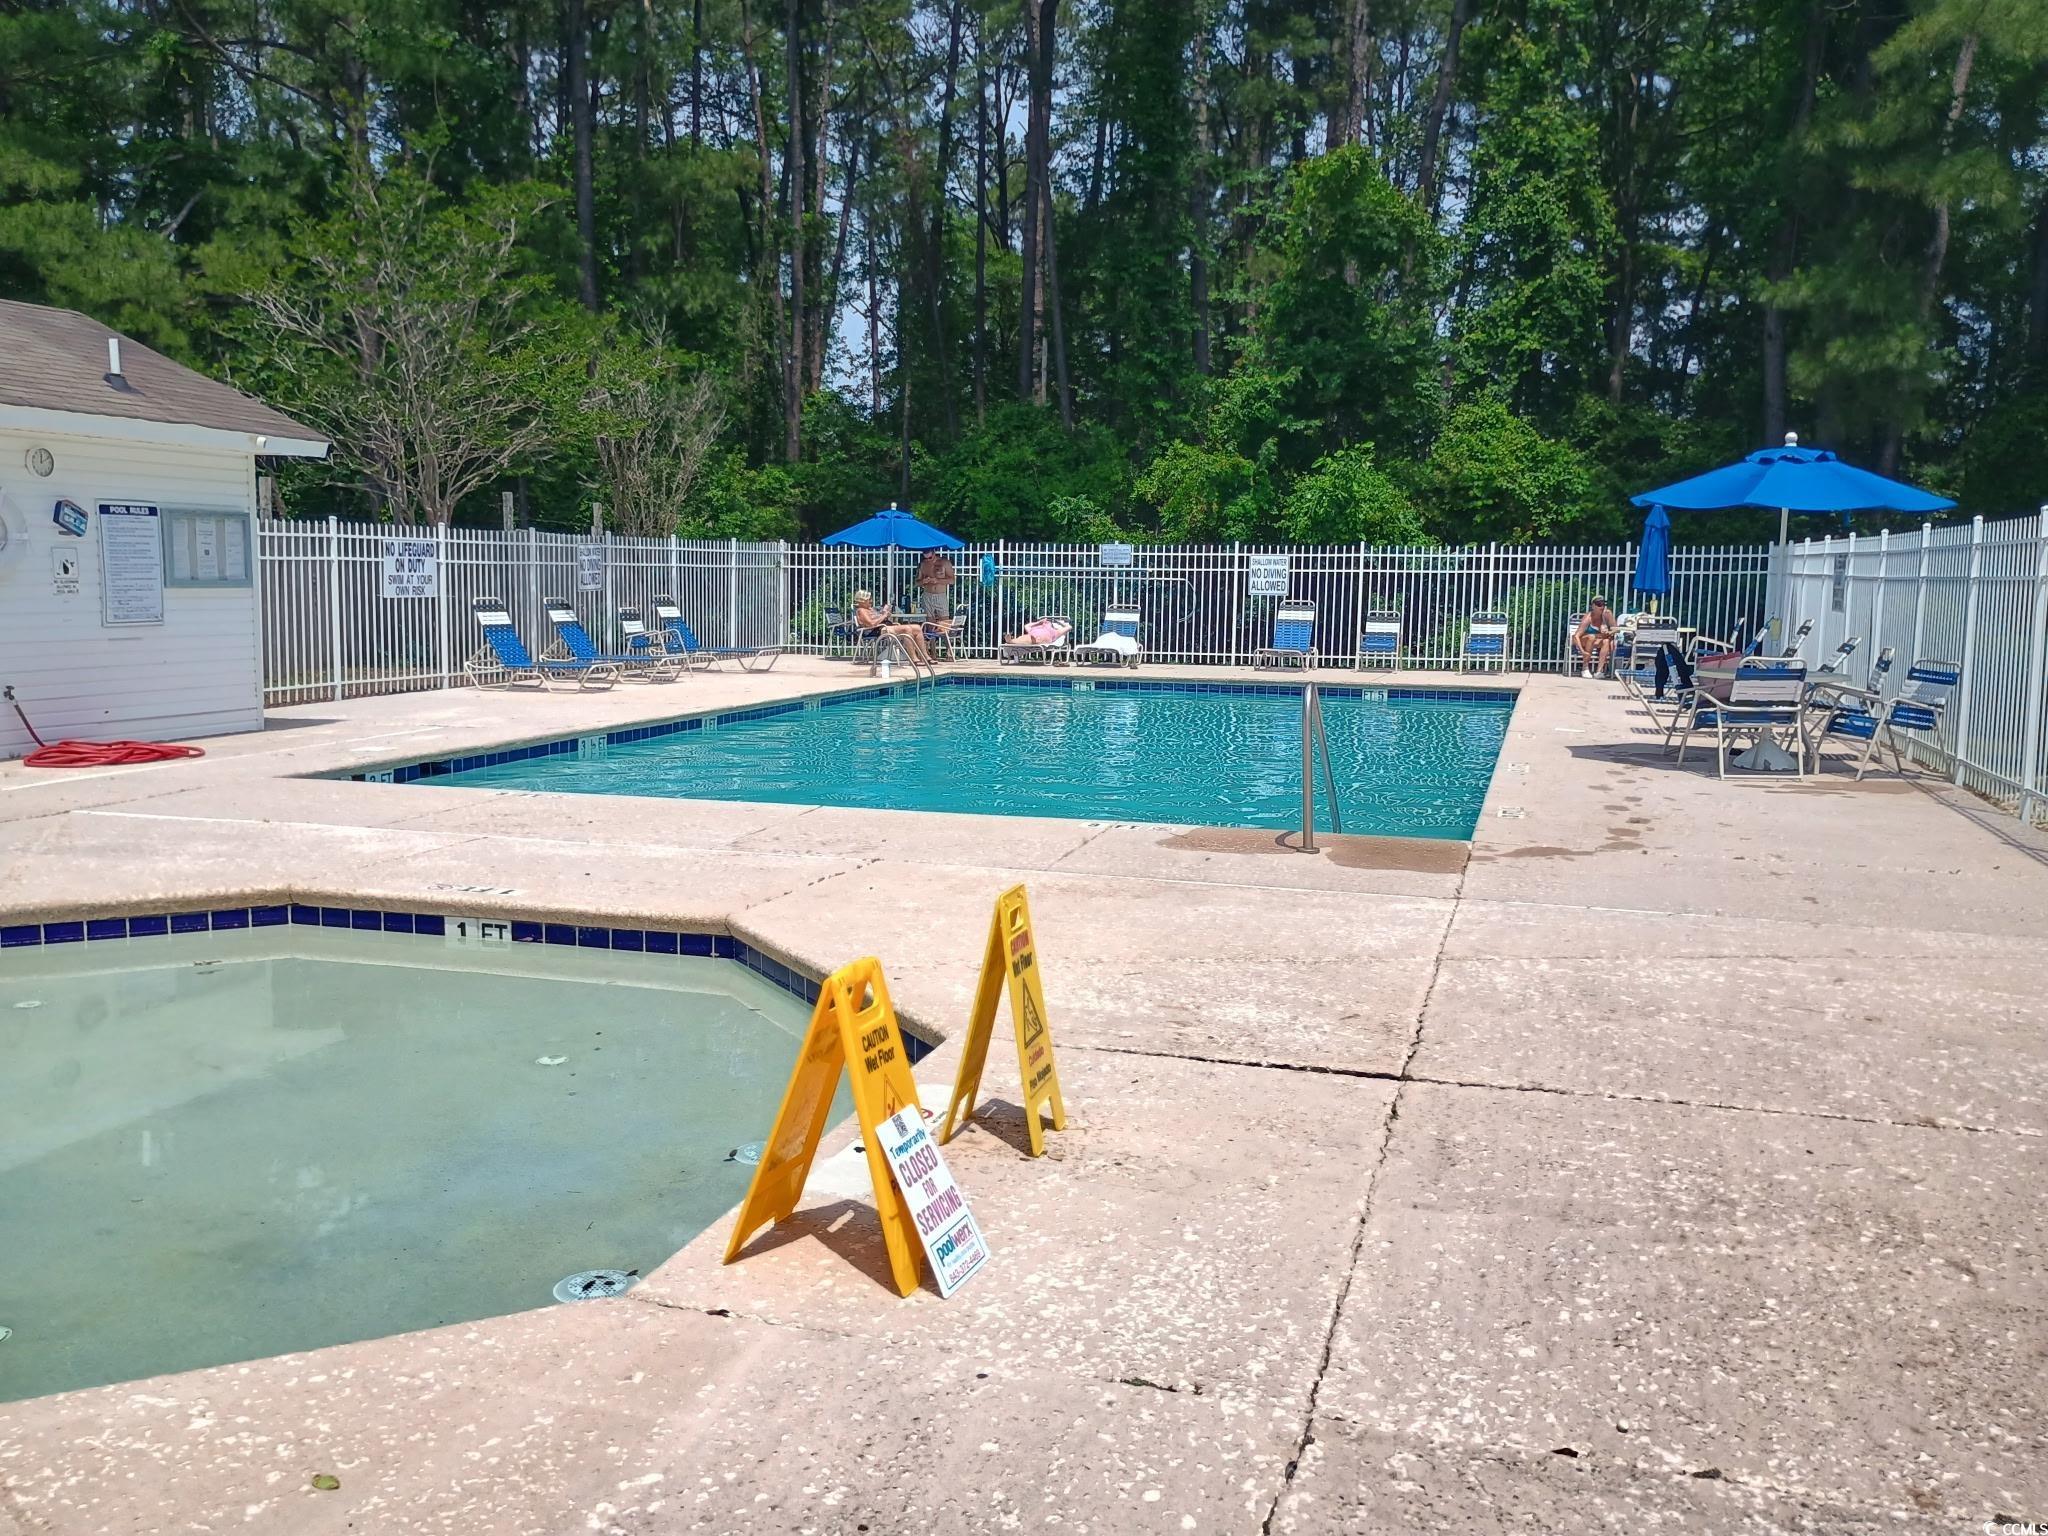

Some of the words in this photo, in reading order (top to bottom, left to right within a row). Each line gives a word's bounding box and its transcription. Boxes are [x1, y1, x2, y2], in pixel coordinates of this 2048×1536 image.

[110, 506, 128, 514] POOL
[385, 541, 396, 557] NO
[398, 541, 435, 558] LIFEGUARD
[395, 558, 405, 573] ON
[408, 558, 426, 574] DUTY
[1251, 568, 1262, 579] NO
[1263, 568, 1287, 579] DIVING
[388, 574, 404, 585] SWIM
[406, 574, 414, 585] AT
[416, 574, 433, 585] YOUR
[1251, 580, 1286, 591] ALLOWED
[395, 586, 410, 596] OWN
[412, 586, 426, 596] RISK
[380, 772, 392, 783] FT
[456, 921, 467, 937] 1
[481, 922, 508, 940] FT
[861, 1023, 890, 1053] CAUTION
[864, 1055, 880, 1074] Wet
[877, 1046, 895, 1067] Floor
[889, 1127, 927, 1160] Temporarily
[898, 1143, 939, 1188] CLOSED
[922, 1177, 938, 1199] FOR
[916, 1184, 963, 1236] SERVICING
[936, 1220, 973, 1267] poolwerx
